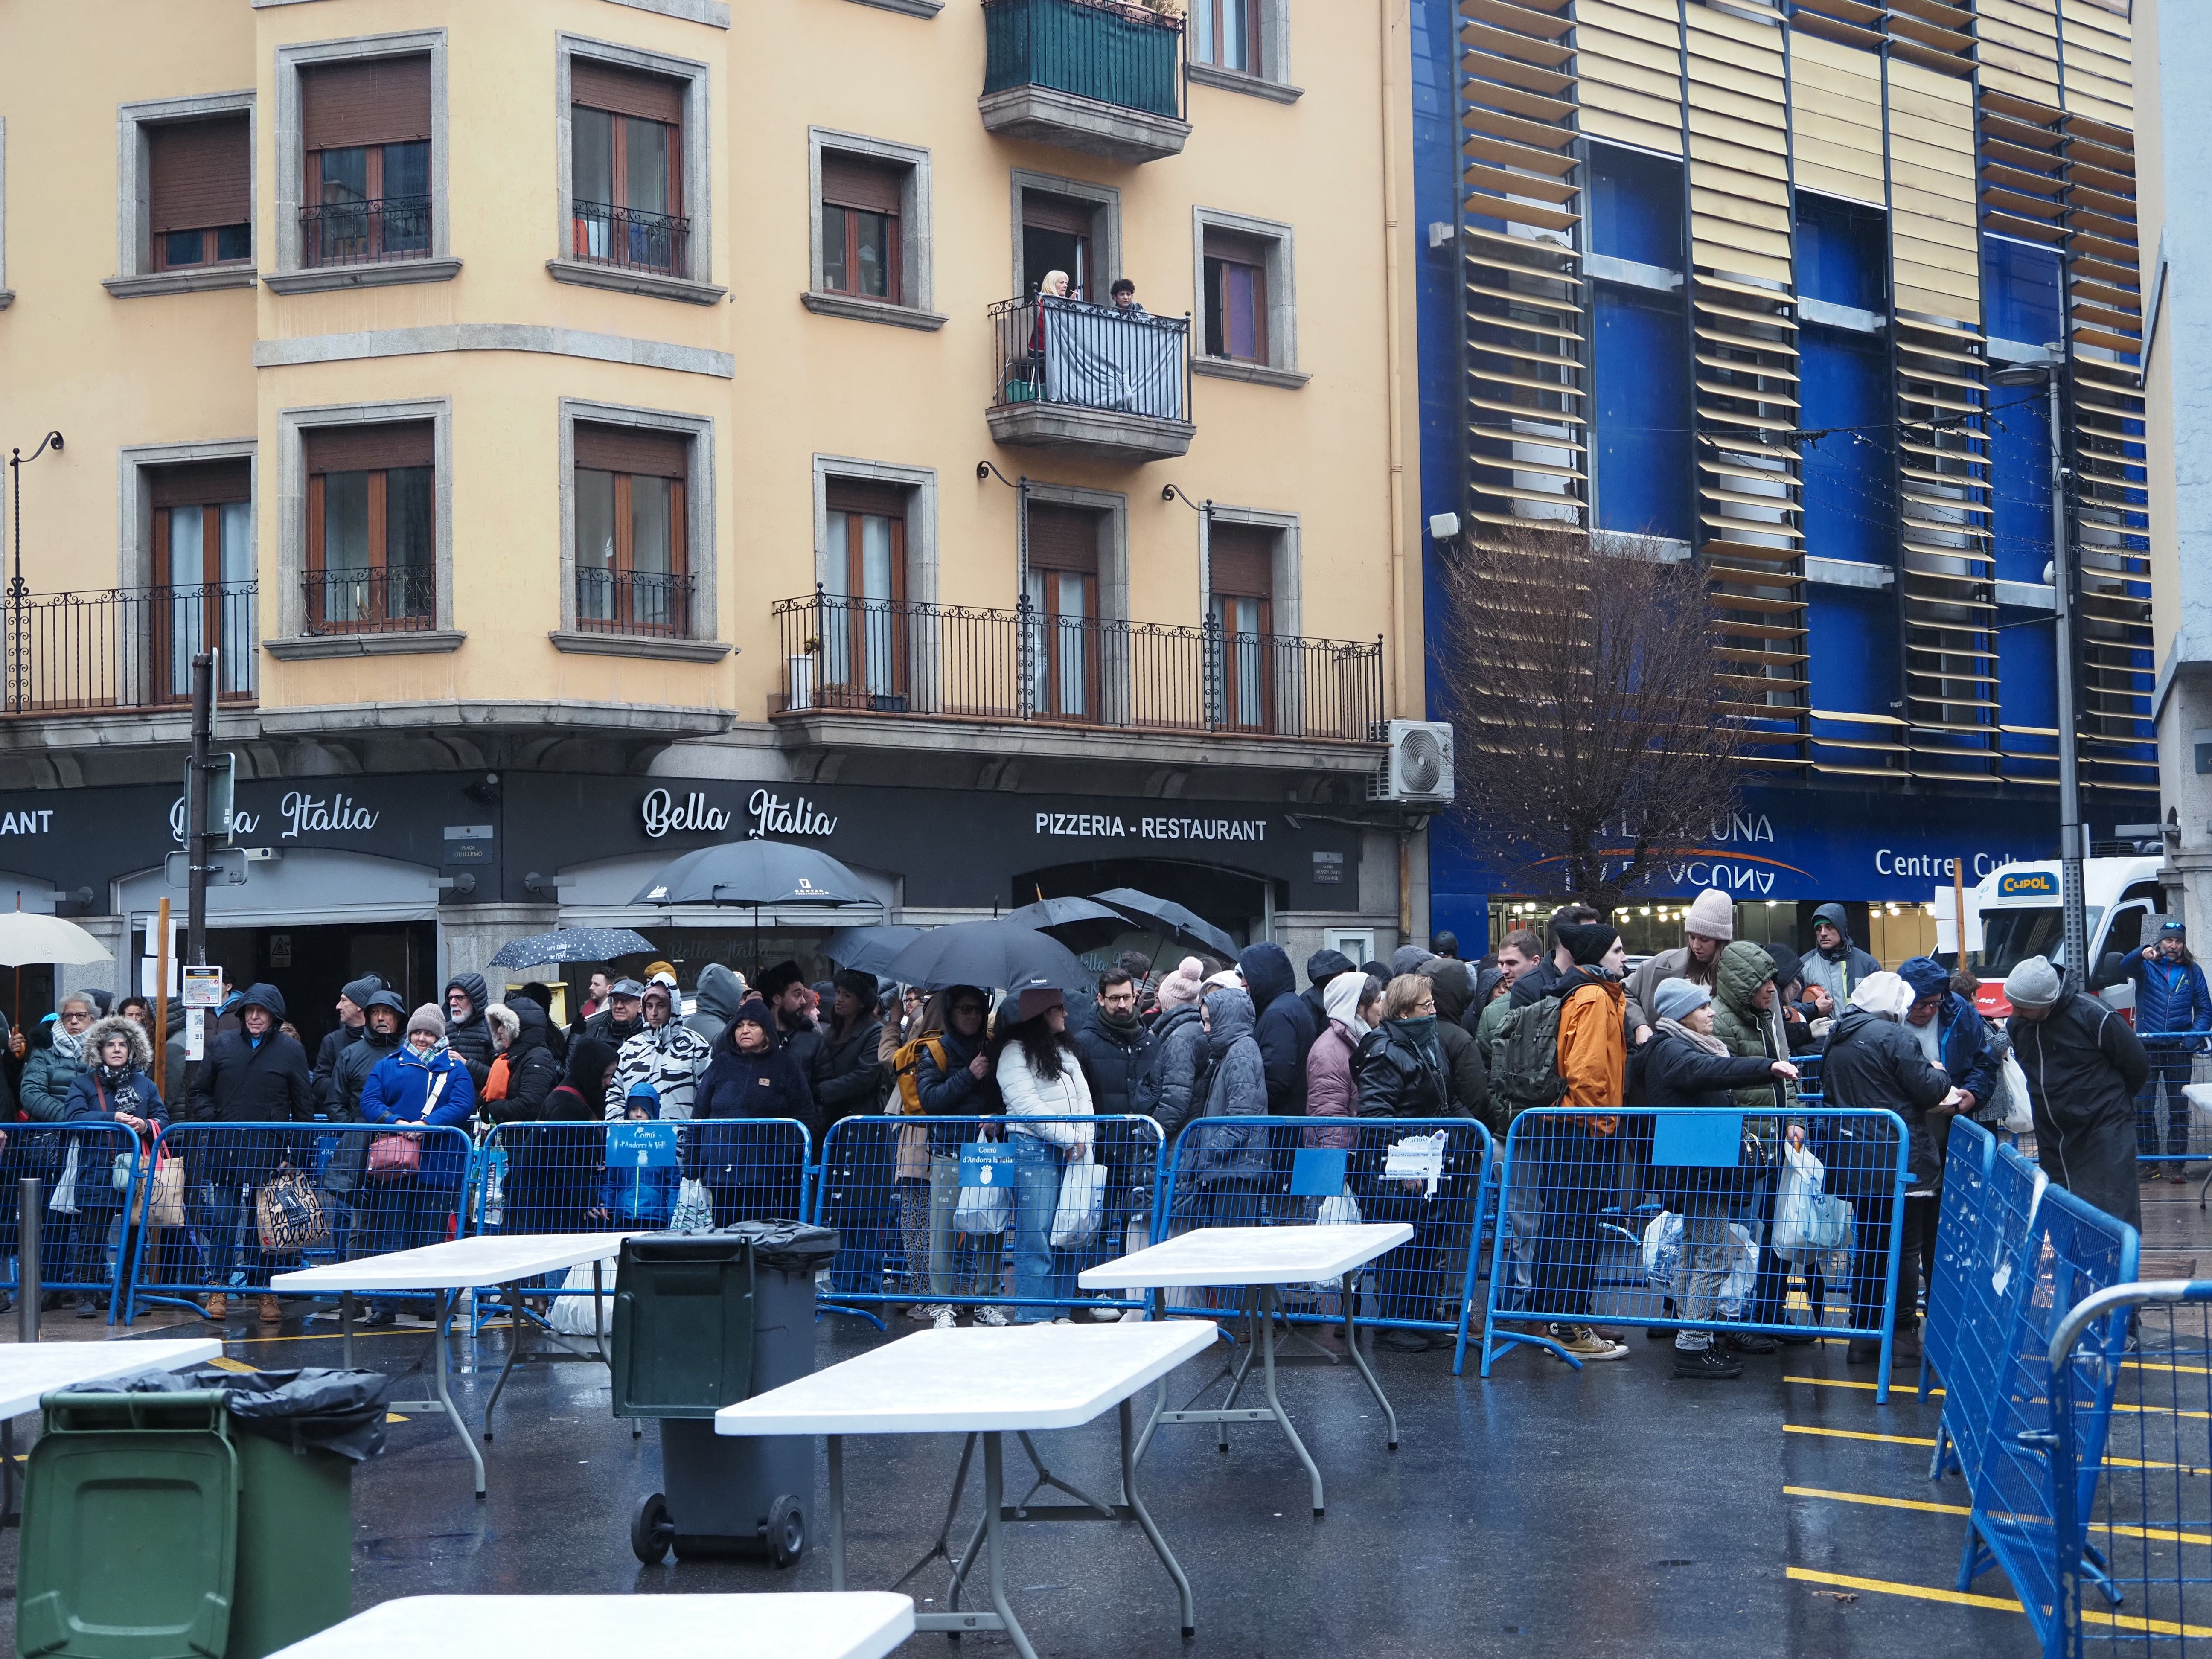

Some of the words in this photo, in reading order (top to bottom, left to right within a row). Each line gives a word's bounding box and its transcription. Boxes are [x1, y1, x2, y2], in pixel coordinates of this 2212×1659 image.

[281, 791, 379, 839] Italia
[642, 788, 731, 838] Bella
[749, 789, 838, 837] Italia
[1036, 813, 1125, 836] PIZZERIA
[1142, 818, 1266, 841] RESTAURANT
[1876, 849, 1954, 877] Centre
[2004, 876, 2049, 892] CLIPOL
